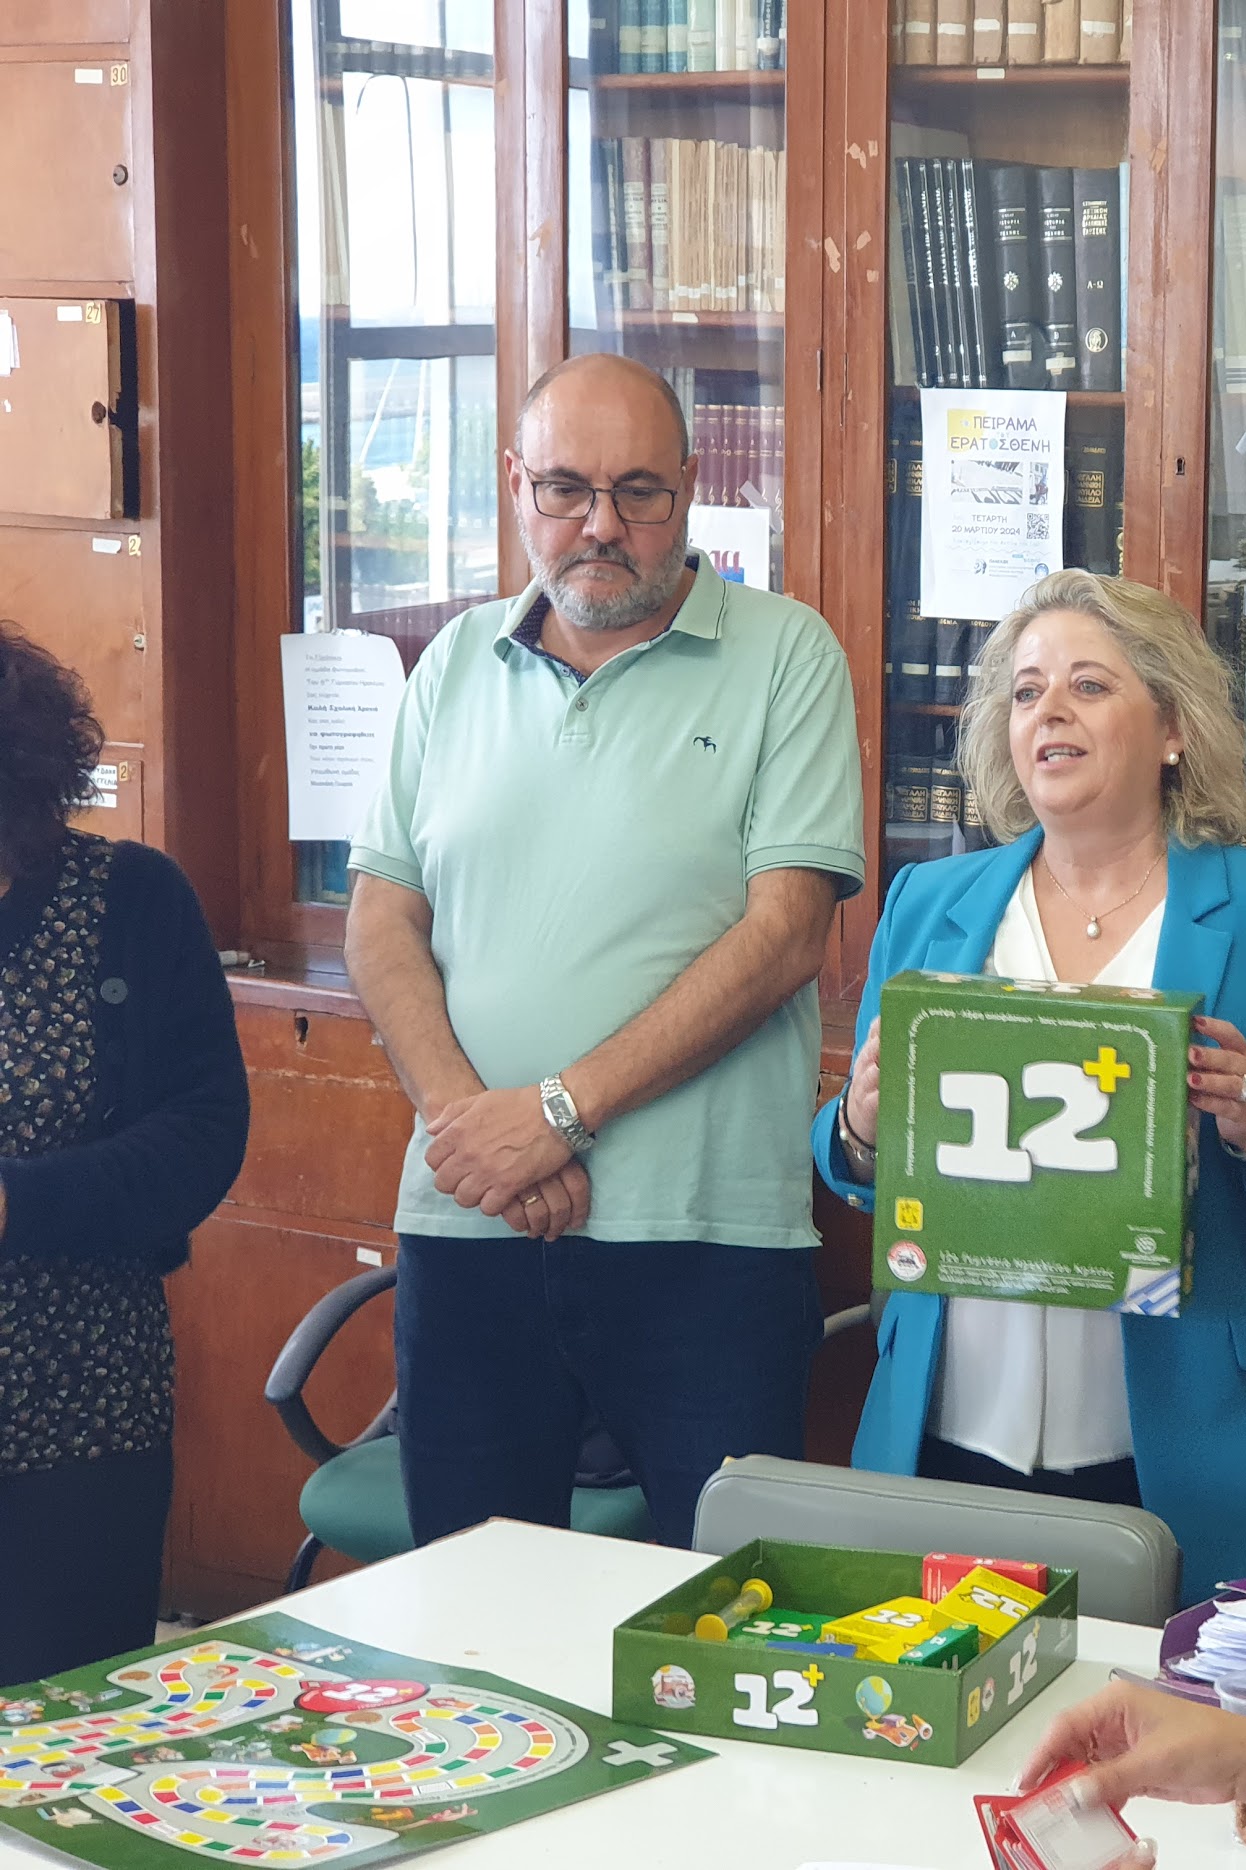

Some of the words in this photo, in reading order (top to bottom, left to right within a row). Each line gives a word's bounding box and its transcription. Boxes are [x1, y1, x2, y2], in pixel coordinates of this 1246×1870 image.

[112, 67, 127, 83] 30
[86, 305, 100, 322] 27
[974, 416, 1037, 431] ΠΕΙΡΑΜΑ
[951, 437, 1050, 452] ΕΡΑΤΟΣΘΕΝΗ
[972, 514, 1008, 523] ΤΕΤΑΡΤΗ
[952, 525, 962, 533] 20
[964, 526, 998, 534] ΜΑΡΤΙΟΥ
